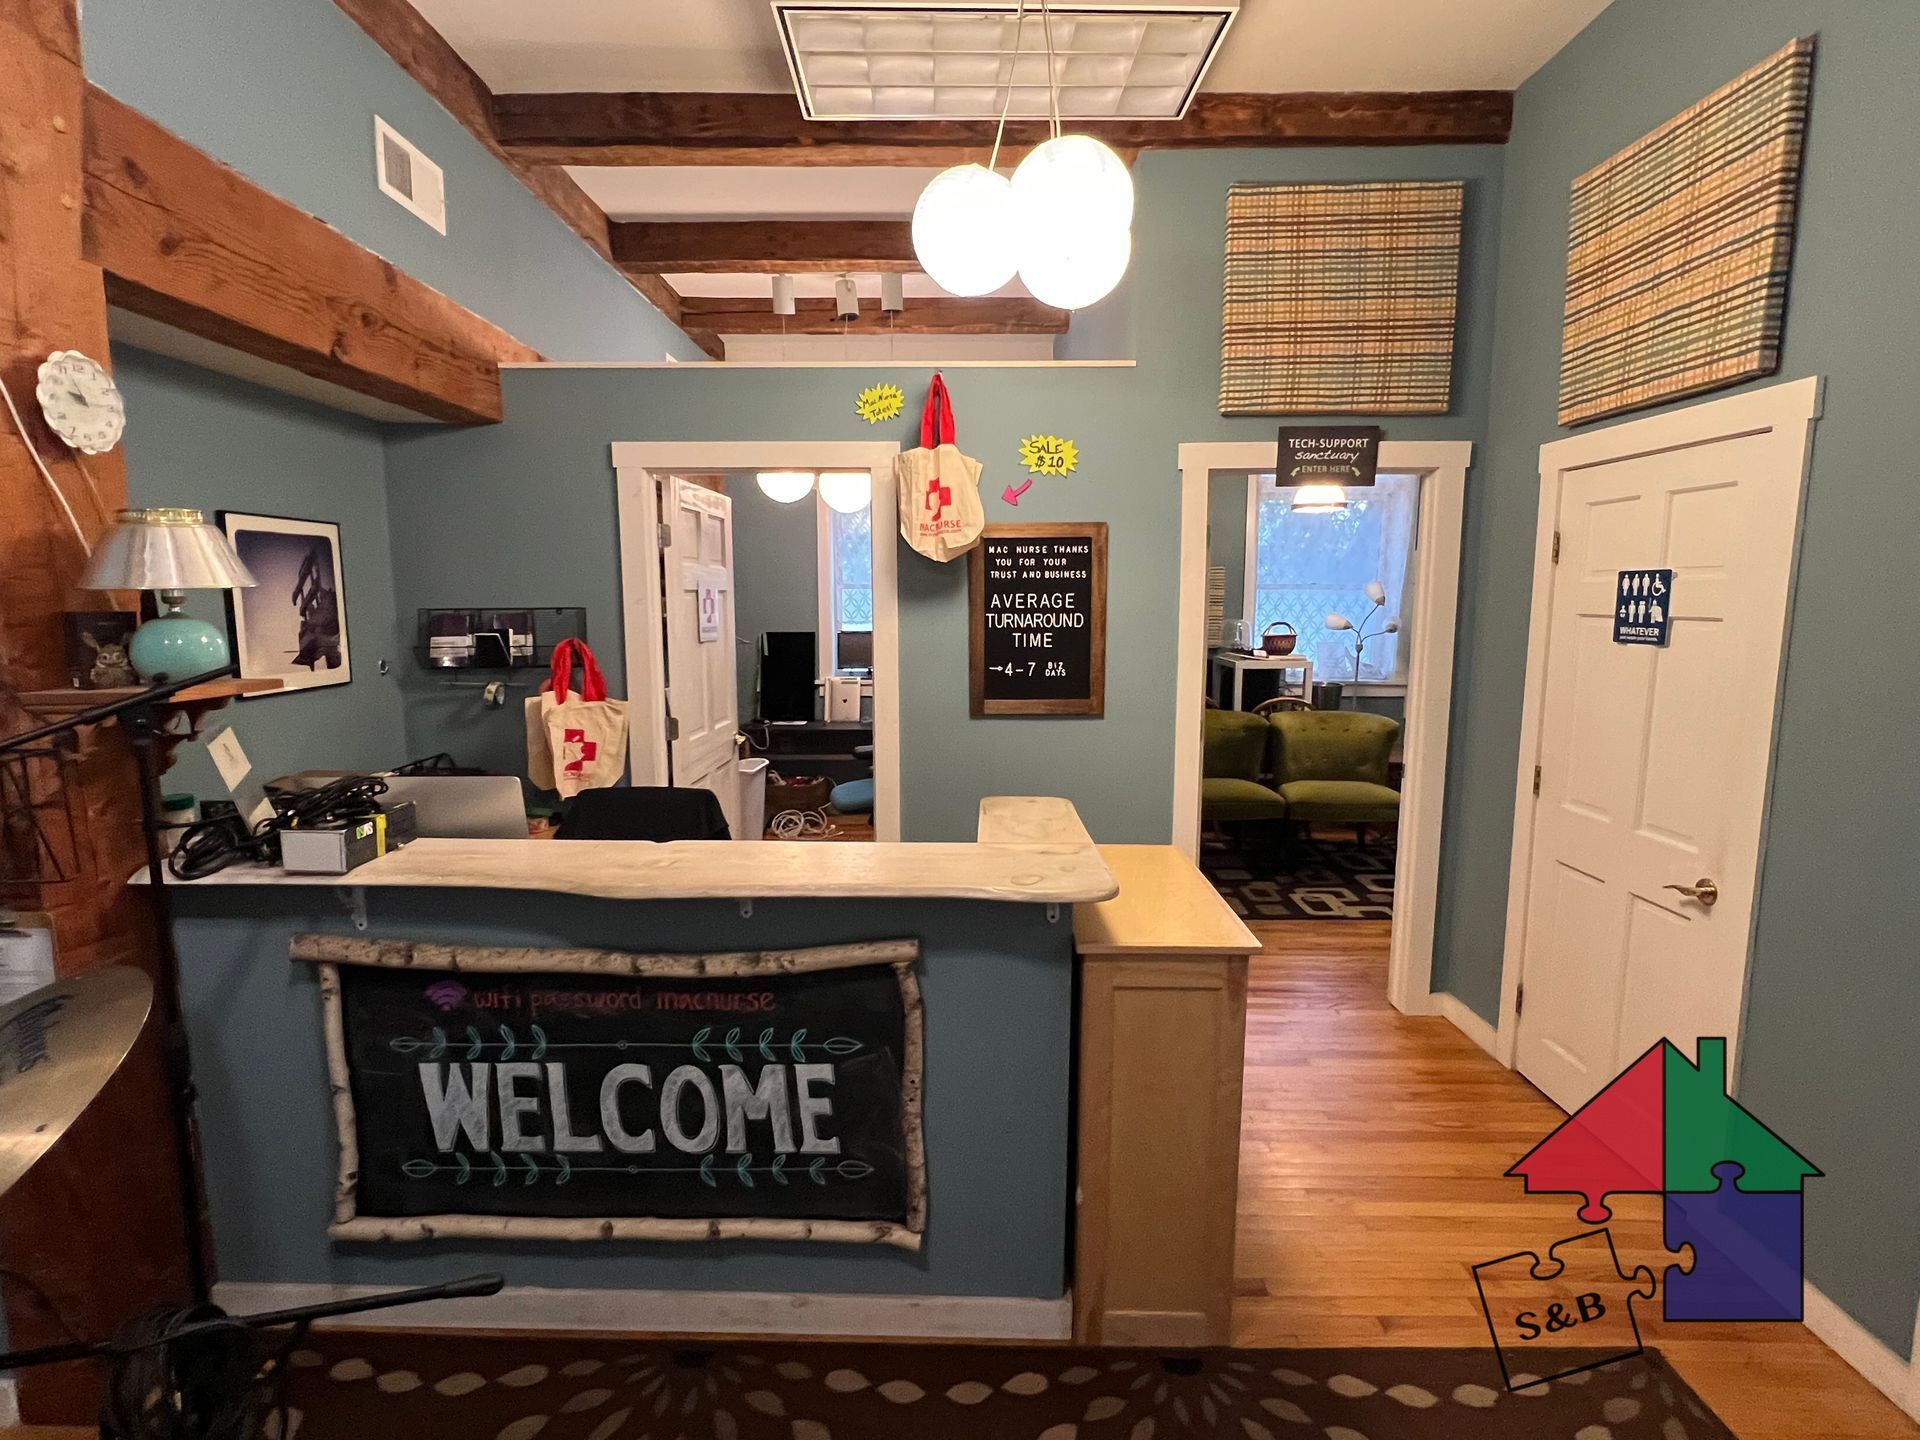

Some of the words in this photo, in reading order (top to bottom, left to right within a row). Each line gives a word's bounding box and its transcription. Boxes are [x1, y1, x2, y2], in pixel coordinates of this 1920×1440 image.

[1029, 440, 1063, 454] SALE
[1289, 439, 1369, 449] TECH-SUPPORT
[1035, 455, 1064, 468] $10
[1294, 449, 1359, 464] sanctuary
[1302, 465, 1327, 473] ENTER
[1329, 465, 1351, 473] HERE
[988, 546, 1009, 554] MAC
[1016, 545, 1048, 554] NURSE
[1053, 545, 1089, 554] THANKS
[995, 558, 1012, 566] YOU
[1019, 558, 1036, 566] FOR
[1043, 558, 1067, 566] YOUR
[990, 570, 1017, 579] TRUST
[1022, 570, 1041, 579] AND
[1044, 570, 1087, 579] BUSINESS
[990, 592, 1075, 609] AVERAGE
[985, 612, 1084, 629] TURNAROUND
[1619, 626, 1660, 636] WHATEVER
[1012, 632, 1053, 648] TIME
[1045, 669, 1066, 677] DAYS
[530, 988, 641, 1017] password
[656, 990, 777, 1011] macnurse
[418, 1061, 842, 1154] WELCOME
